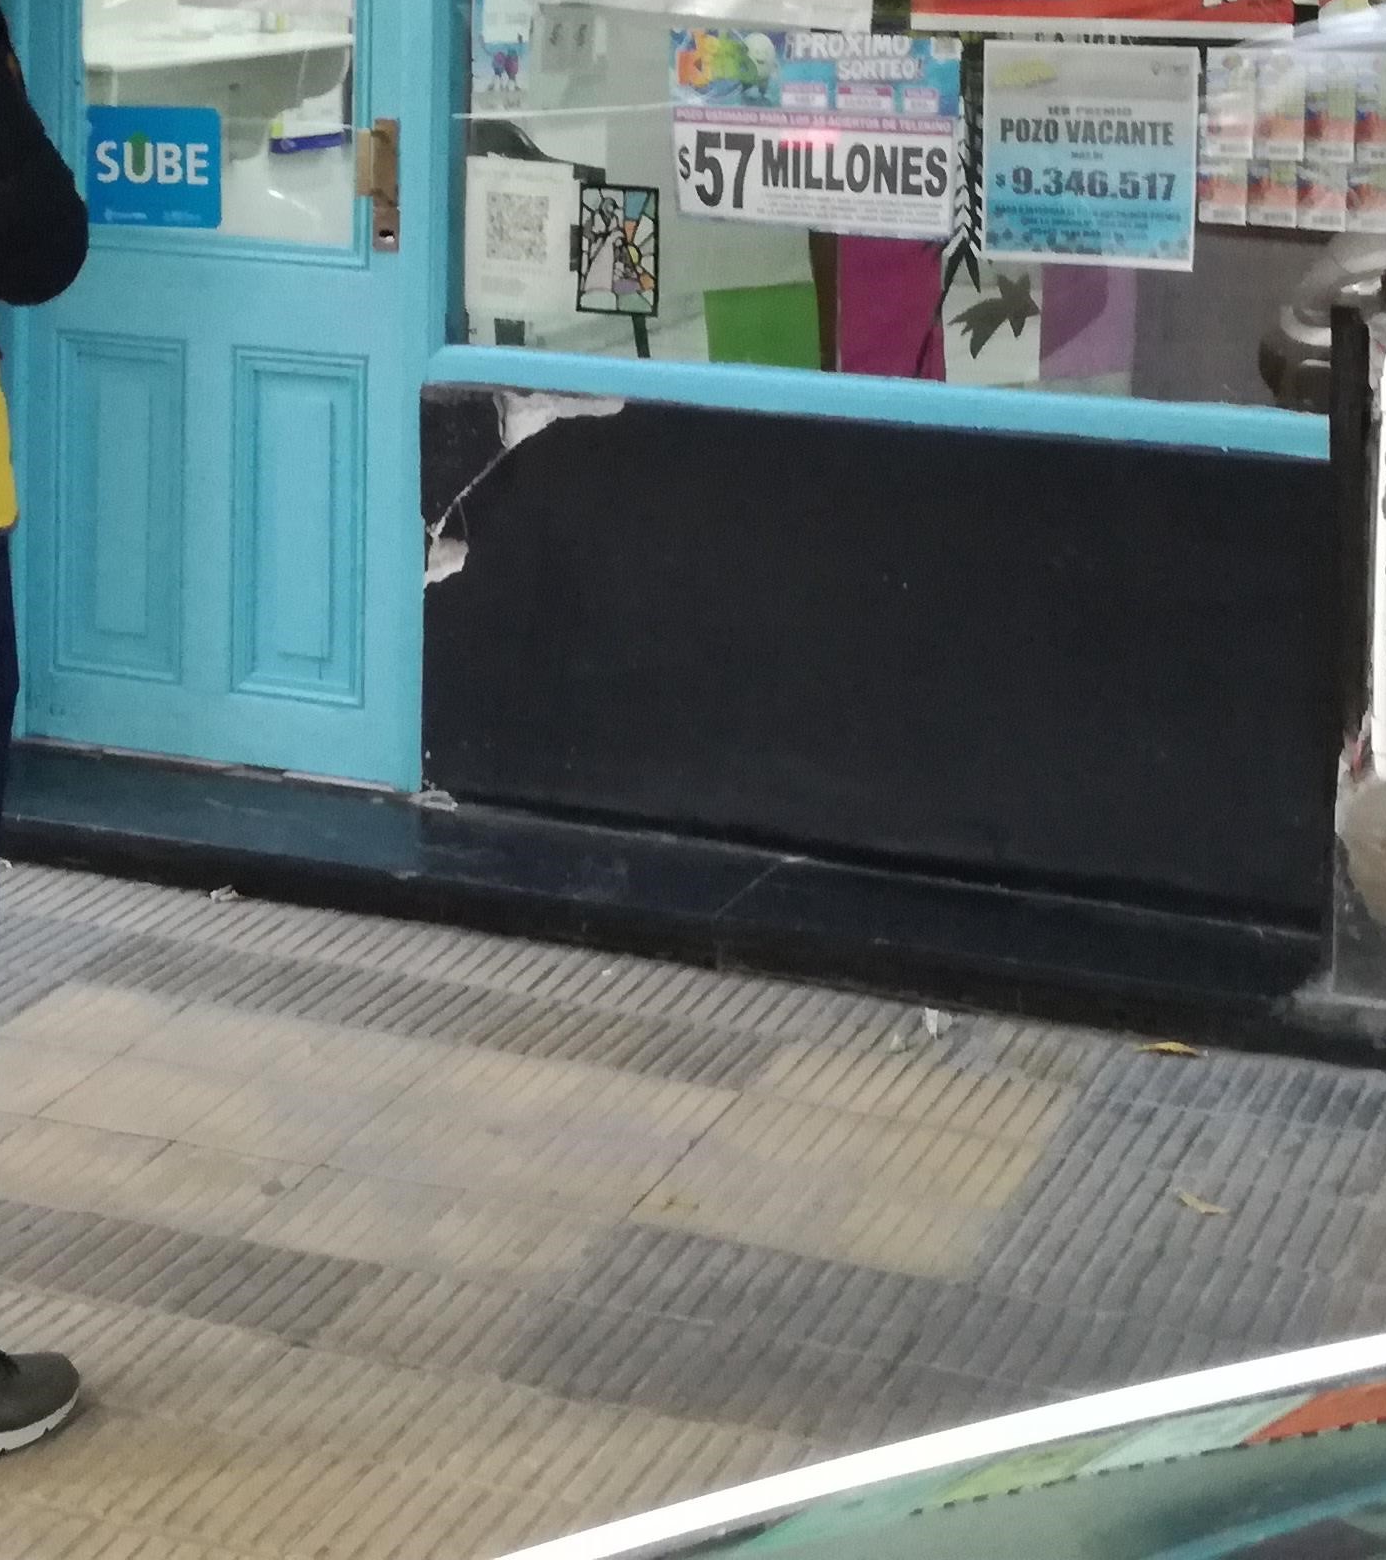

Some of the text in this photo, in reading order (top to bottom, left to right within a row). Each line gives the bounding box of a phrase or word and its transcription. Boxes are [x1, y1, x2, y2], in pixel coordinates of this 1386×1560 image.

[1000, 117, 1174, 146] POZO VACANTE
[96, 139, 210, 186] SUBE
[762, 139, 949, 197] MILLONES
[1012, 163, 1178, 202] 9.346.517
